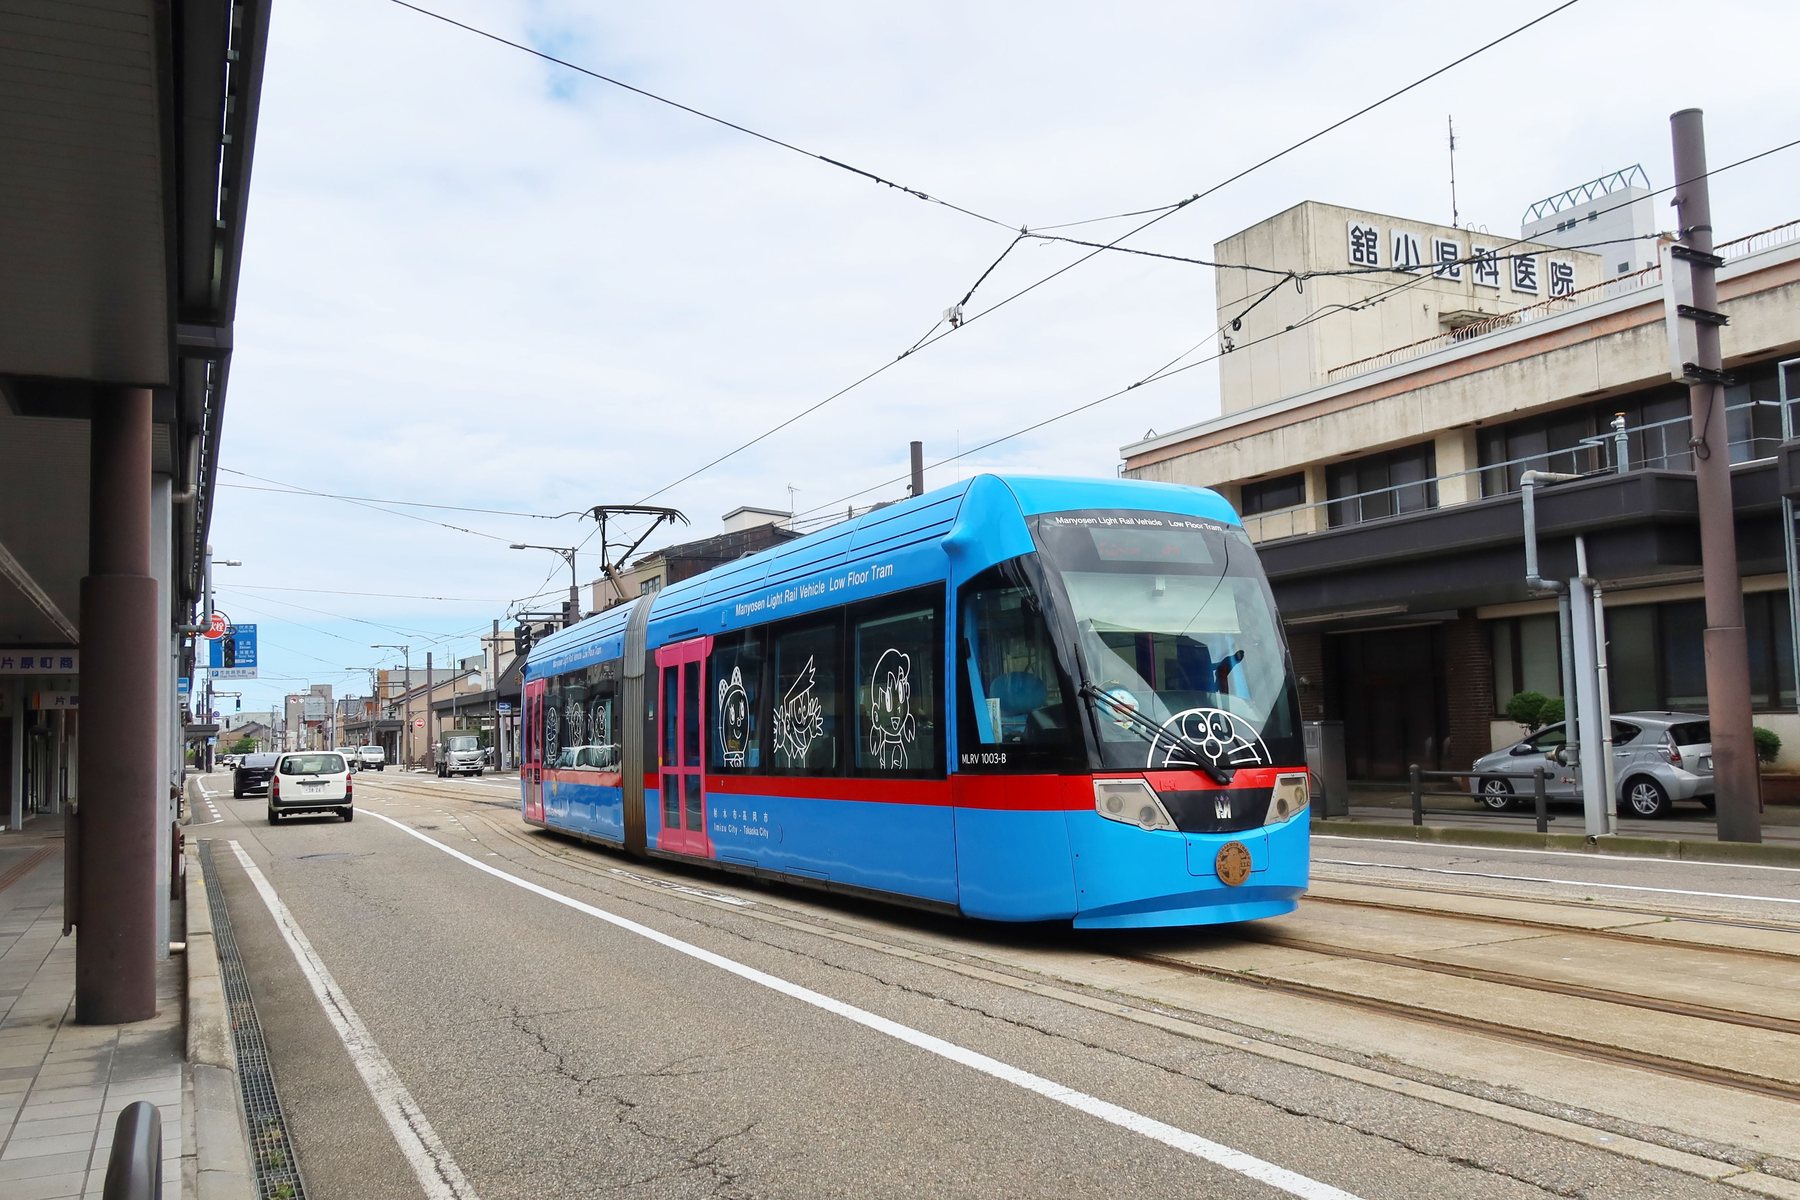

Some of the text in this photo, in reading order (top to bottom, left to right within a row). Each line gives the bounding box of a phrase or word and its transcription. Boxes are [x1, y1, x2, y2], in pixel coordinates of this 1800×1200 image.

[1350, 225, 1575, 297] 舘小児科医院
[1055, 516, 1223, 532] Manyosen Light Rail Vehicle Low Floor Tram
[735, 563, 893, 616] Manyosen Light Rail Vehicle Low Floor Tram
[961, 752, 1007, 764] MLRV 1003-B
[727, 824, 738, 836] City
[759, 827, 769, 840] City
